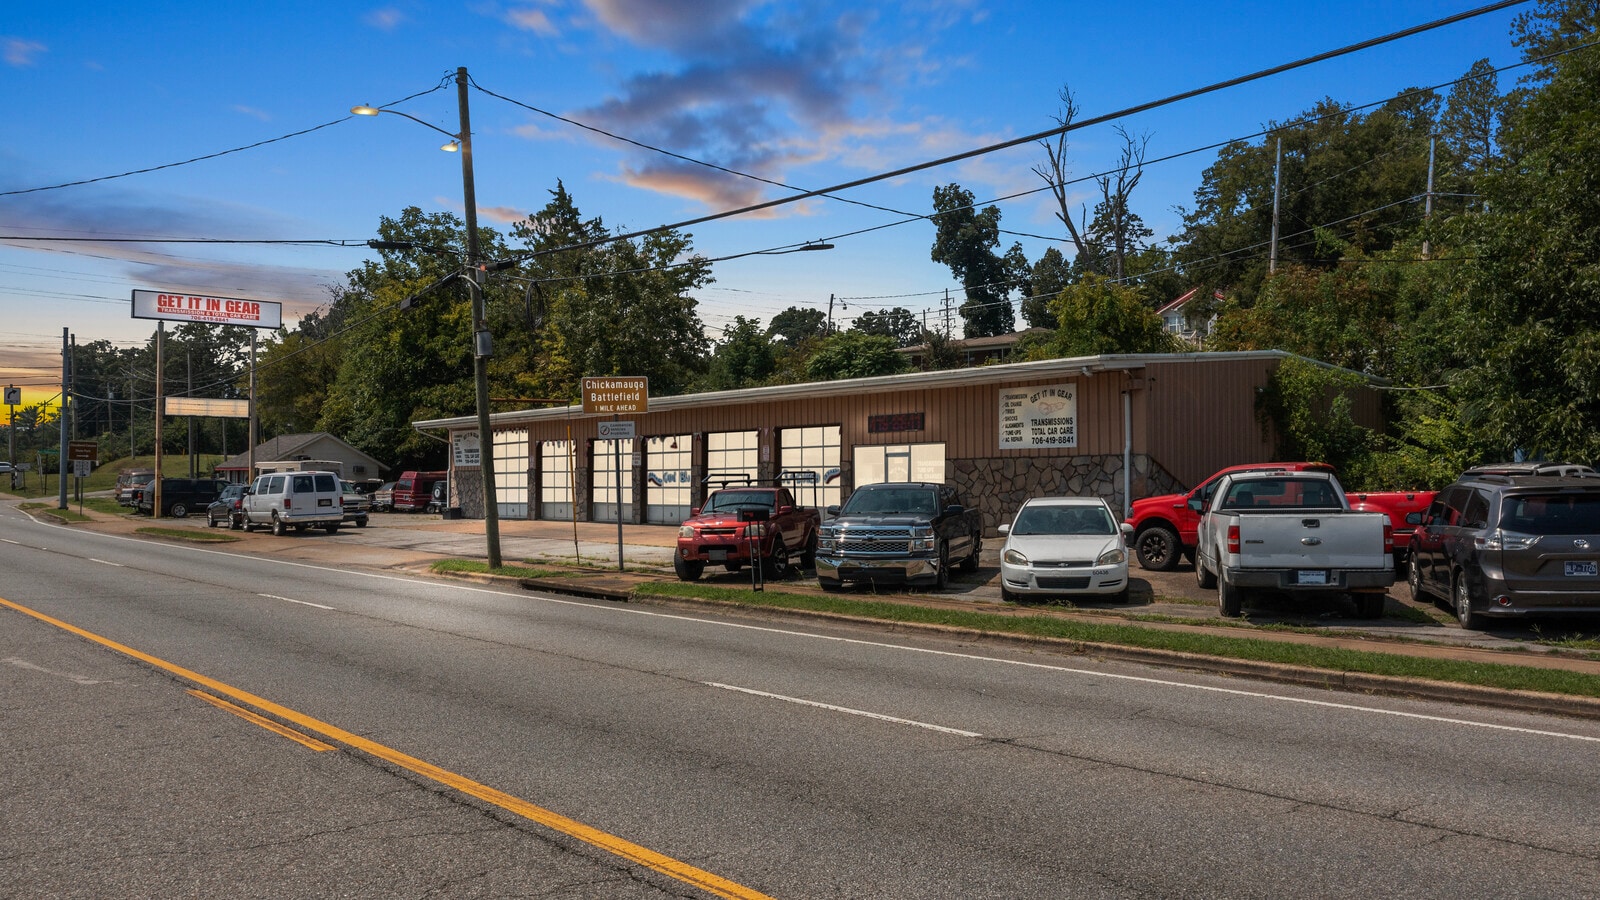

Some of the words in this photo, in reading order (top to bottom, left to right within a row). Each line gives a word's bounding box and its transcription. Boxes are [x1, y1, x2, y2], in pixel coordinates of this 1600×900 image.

[157, 294, 184, 308] GET
[188, 296, 202, 309] IT
[206, 298, 220, 312] IN
[225, 300, 260, 314] GEAR
[190, 315, 229, 323] 706-419-8841
[585, 380, 644, 391] Chickamauga
[591, 392, 640, 402] Battlefield
[1030, 392, 1041, 404] GET
[1042, 389, 1048, 398] IT
[1050, 389, 1056, 397] IN
[1057, 389, 1073, 401] GEAR
[1031, 417, 1074, 426] TRANSMISSIONS
[1031, 427, 1046, 435] TOTAL
[1047, 427, 1058, 435] CAR
[1060, 426, 1074, 434] CARE
[1031, 436, 1074, 445] 706-419-8841
